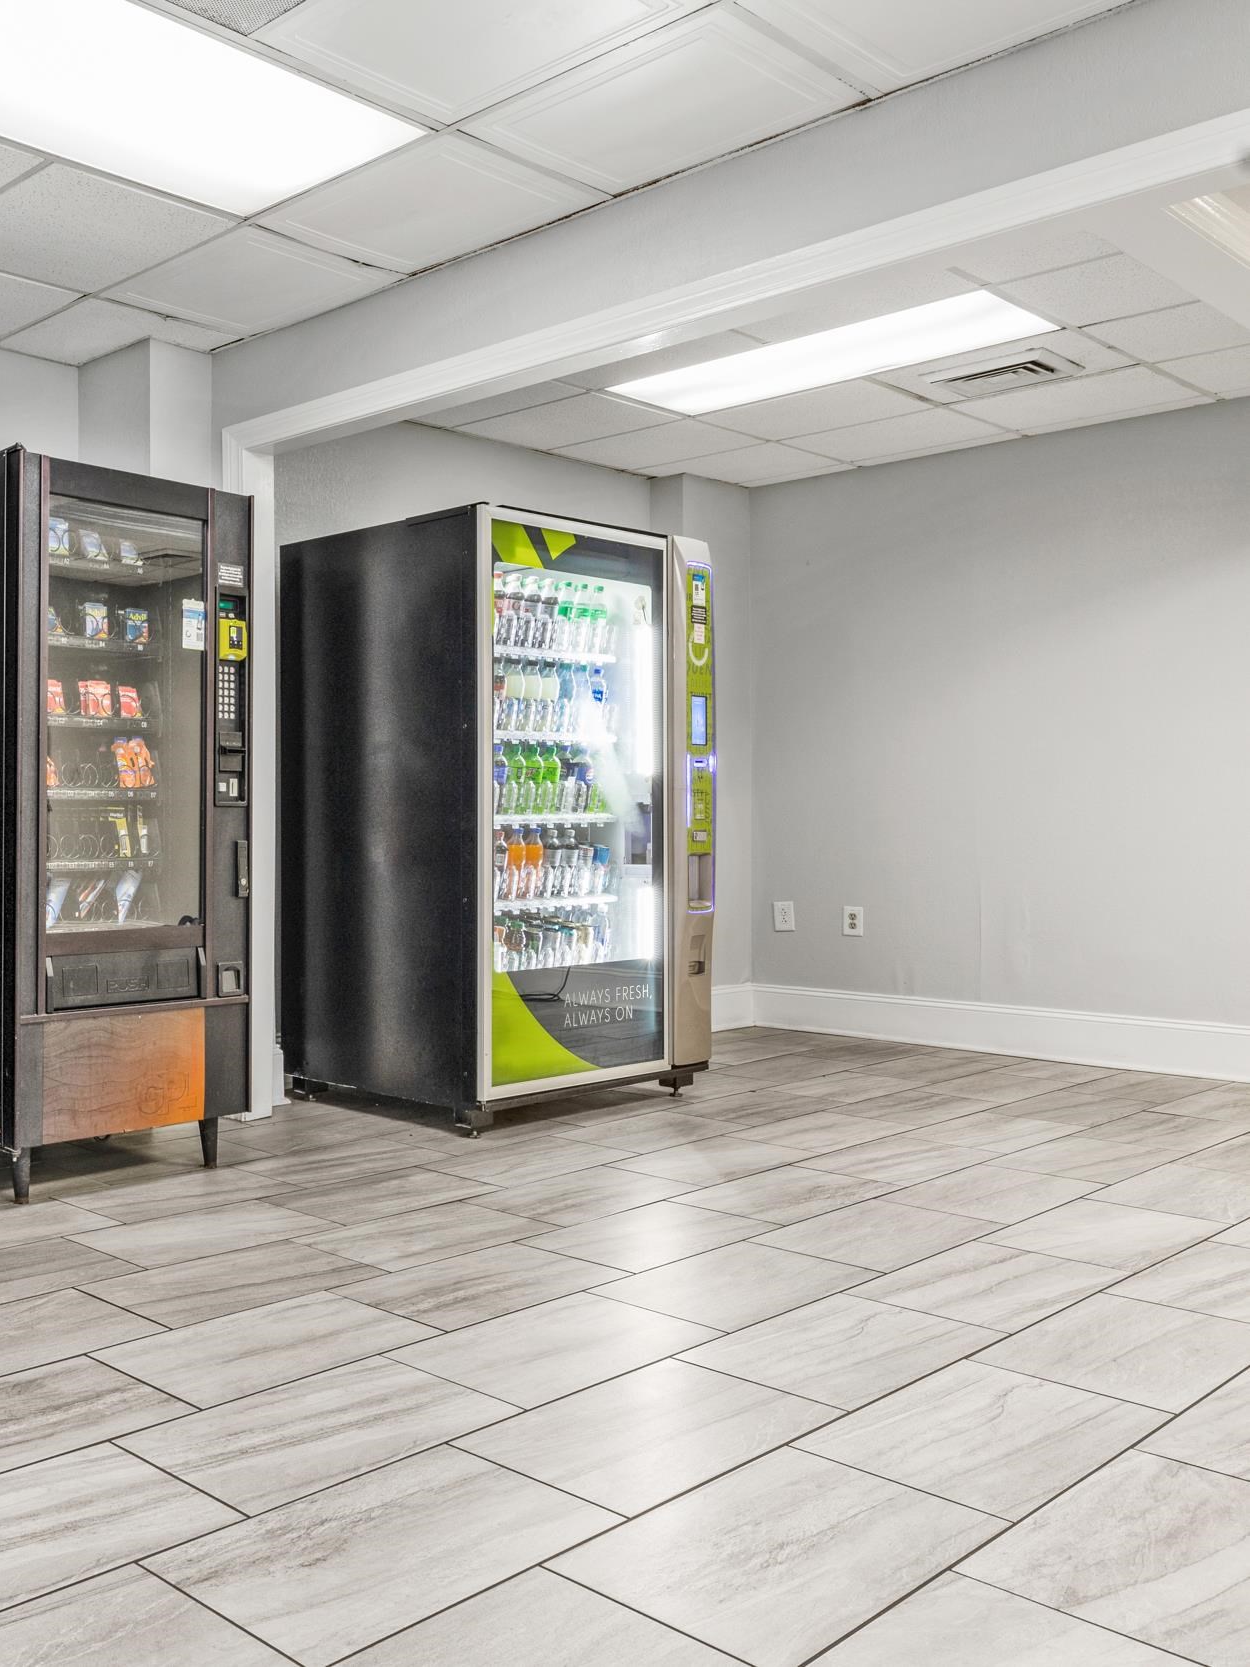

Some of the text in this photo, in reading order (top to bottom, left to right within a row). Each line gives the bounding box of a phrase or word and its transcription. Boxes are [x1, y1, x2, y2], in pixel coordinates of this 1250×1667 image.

[129, 613, 147, 622] Advil
[564, 983, 653, 1008] ALWAYS FRESH,
[564, 1005, 633, 1028] ALWAYS ON
